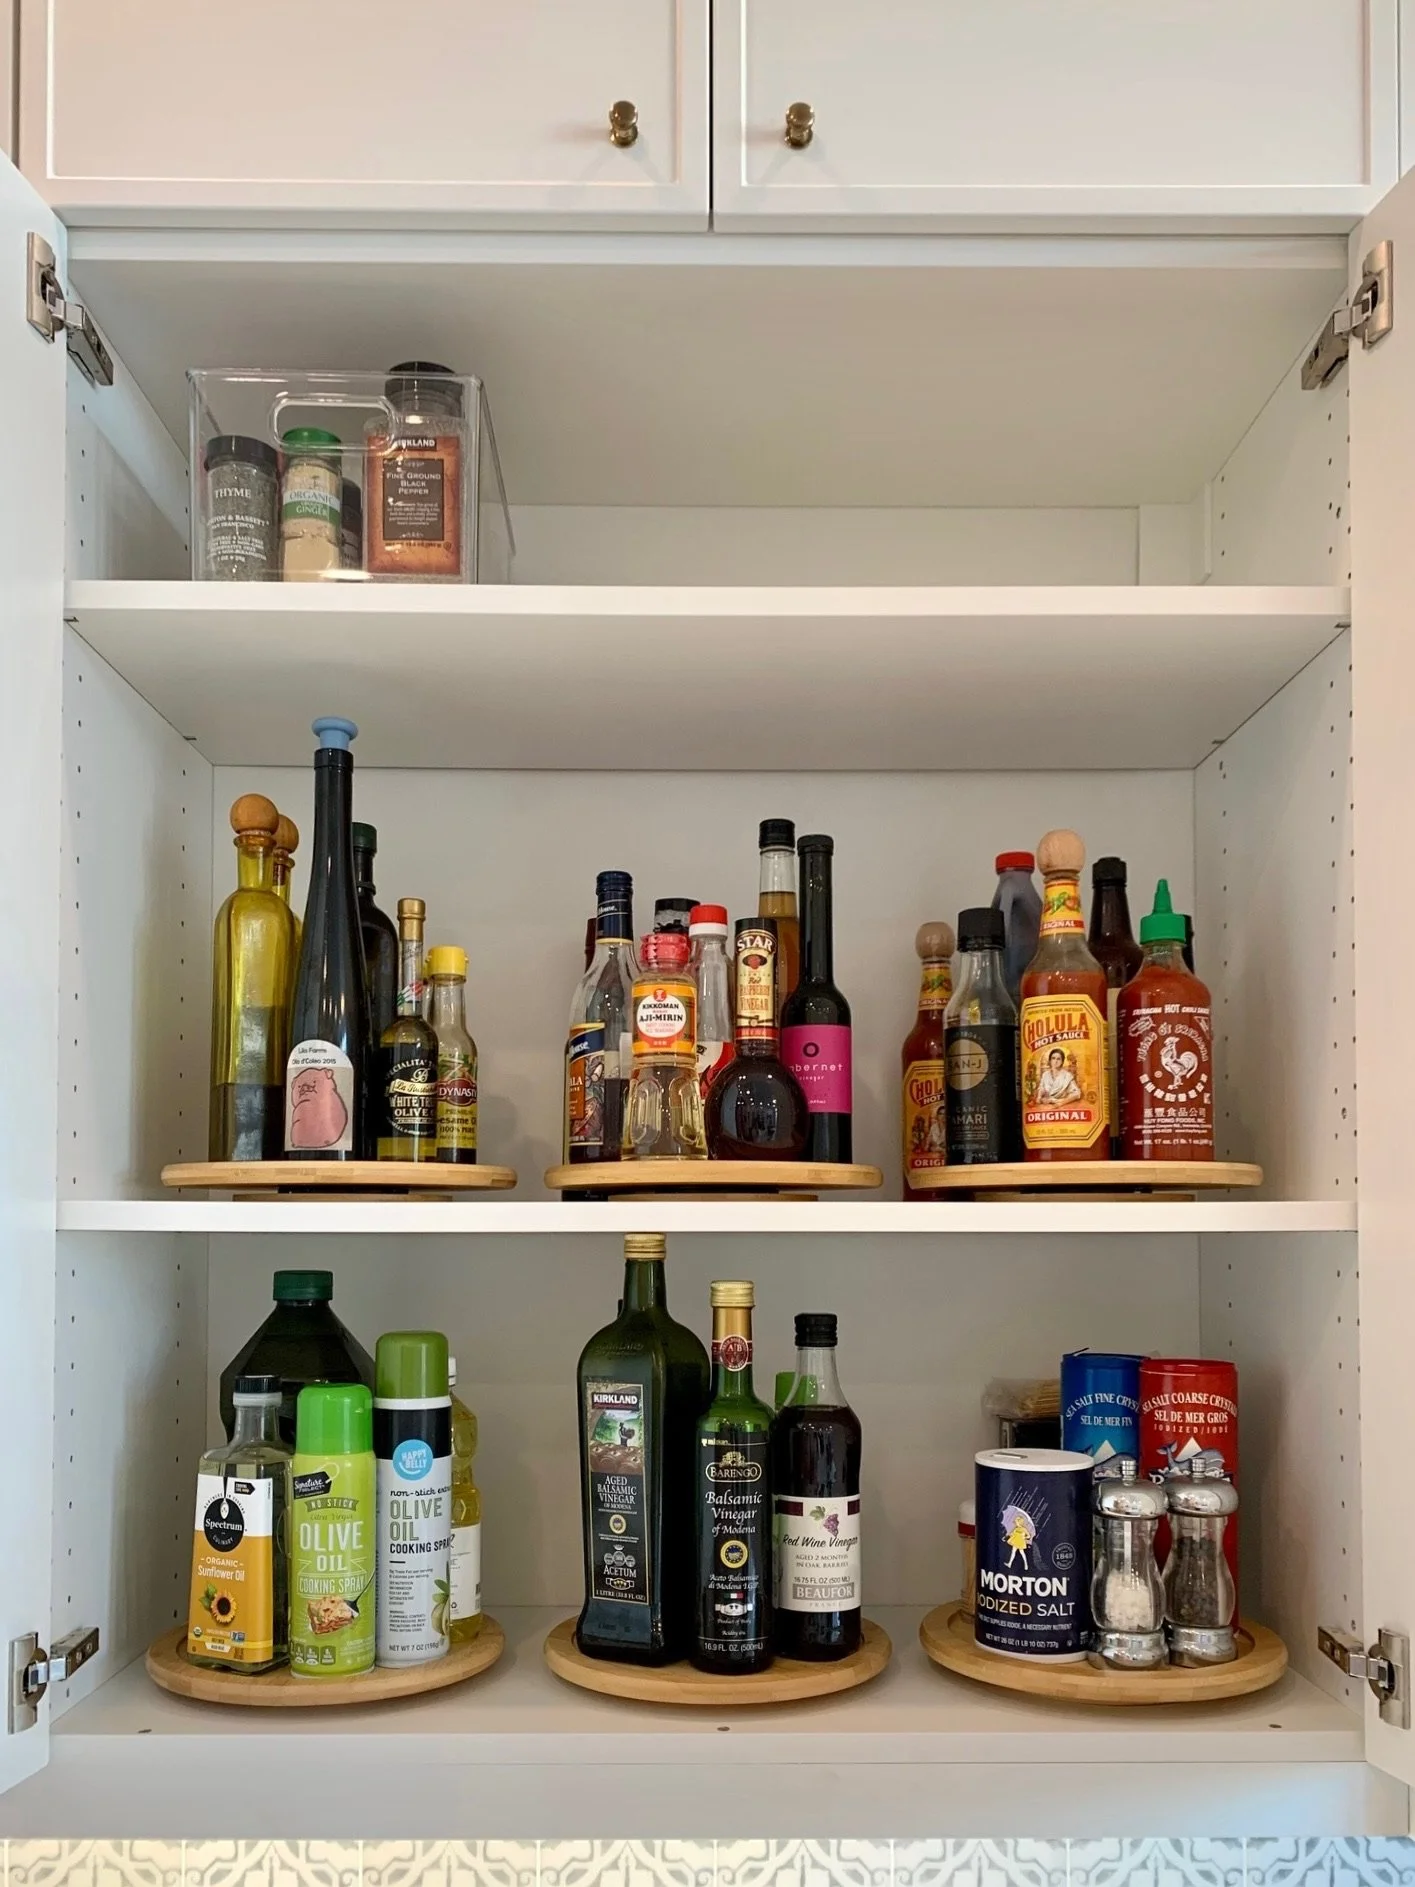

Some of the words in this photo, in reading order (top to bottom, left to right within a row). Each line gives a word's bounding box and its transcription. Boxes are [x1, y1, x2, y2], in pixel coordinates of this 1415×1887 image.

[401, 480, 426, 488] BLACK
[215, 487, 251, 499] THYME
[290, 491, 332, 506] ORGANIC
[296, 504, 329, 515] GINGER
[236, 515, 265, 526] BASSETT
[737, 936, 774, 952] STAR
[748, 976, 761, 984] Red
[741, 998, 768, 1010] VINEGAR
[1132, 1007, 1162, 1016] SRIRACHA
[1164, 1004, 1181, 1013] HOT
[639, 1014, 683, 1023] AJI-MIRIN
[1023, 1012, 1089, 1050] CHOLULA
[1034, 1037, 1054, 1049] HOT
[1056, 1031, 1083, 1042] SAUCE
[948, 1060, 983, 1070] SAN-J
[390, 1095, 419, 1107] WHITE
[923, 1094, 941, 1104] HOT
[394, 1108, 428, 1117] OLIVE
[1027, 1111, 1088, 1122] ORIGINAL
[593, 1394, 638, 1404] KIRKLAND
[1151, 1394, 1170, 1409] SALT
[1171, 1392, 1209, 1405] COARSE
[1065, 1405, 1077, 1420] SEA
[1075, 1394, 1093, 1409] SALT
[1094, 1393, 1116, 1404] FINE
[1080, 1415, 1092, 1425] SEL
[1093, 1416, 1104, 1426] DE
[1104, 1416, 1121, 1426] MER
[1121, 1416, 1133, 1427] FIN
[1154, 1410, 1169, 1421] SEL
[1170, 1411, 1183, 1423] DE
[1185, 1412, 1205, 1423] MER
[1207, 1411, 1228, 1423] GROS
[401, 1448, 427, 1460] HAPPY
[405, 1459, 427, 1469] BELLY
[709, 1466, 758, 1478] BARENGO
[294, 1478, 324, 1490] Signature
[605, 1475, 628, 1486] AGED
[390, 1488, 436, 1497] non-stick
[597, 1484, 637, 1495] BALSAMIC
[599, 1493, 636, 1505] VINEGAR
[705, 1489, 763, 1505] Balsamic
[311, 1500, 322, 1508] NO
[327, 1499, 353, 1508] STICK
[390, 1497, 443, 1520] OLIVE
[711, 1507, 757, 1525] Vinegar
[205, 1518, 243, 1531] Spectrum
[712, 1523, 721, 1537] of
[722, 1524, 756, 1534] Modena
[299, 1520, 364, 1551] OLIVE
[390, 1521, 419, 1542] OIL
[212, 1534, 235, 1545] CULINARY
[783, 1534, 800, 1546] Red
[801, 1536, 826, 1548] Wine
[829, 1536, 858, 1552] Vinegar
[390, 1542, 432, 1554] COOKING
[206, 1556, 238, 1567] ORGANIC
[316, 1554, 347, 1571] OIL
[198, 1565, 234, 1579] Sunflower
[235, 1570, 245, 1581] Oil
[603, 1565, 637, 1578] ACETUM
[299, 1577, 335, 1593] COOKING
[338, 1576, 365, 1593] SPRAY
[708, 1581, 715, 1589] di
[716, 1582, 742, 1590] Modena
[981, 1569, 1067, 1597] MORTON
[796, 1585, 853, 1599] BEAUFOR
[1037, 1602, 1075, 1617] SALT
[990, 1618, 1006, 1627] SUPPLIES
[1027, 1623, 1053, 1631] NECESSARY
[1053, 1623, 1072, 1631] NUTRIENT
[704, 1642, 718, 1651] 16.9
[1008, 1637, 1015, 1645] OZ
